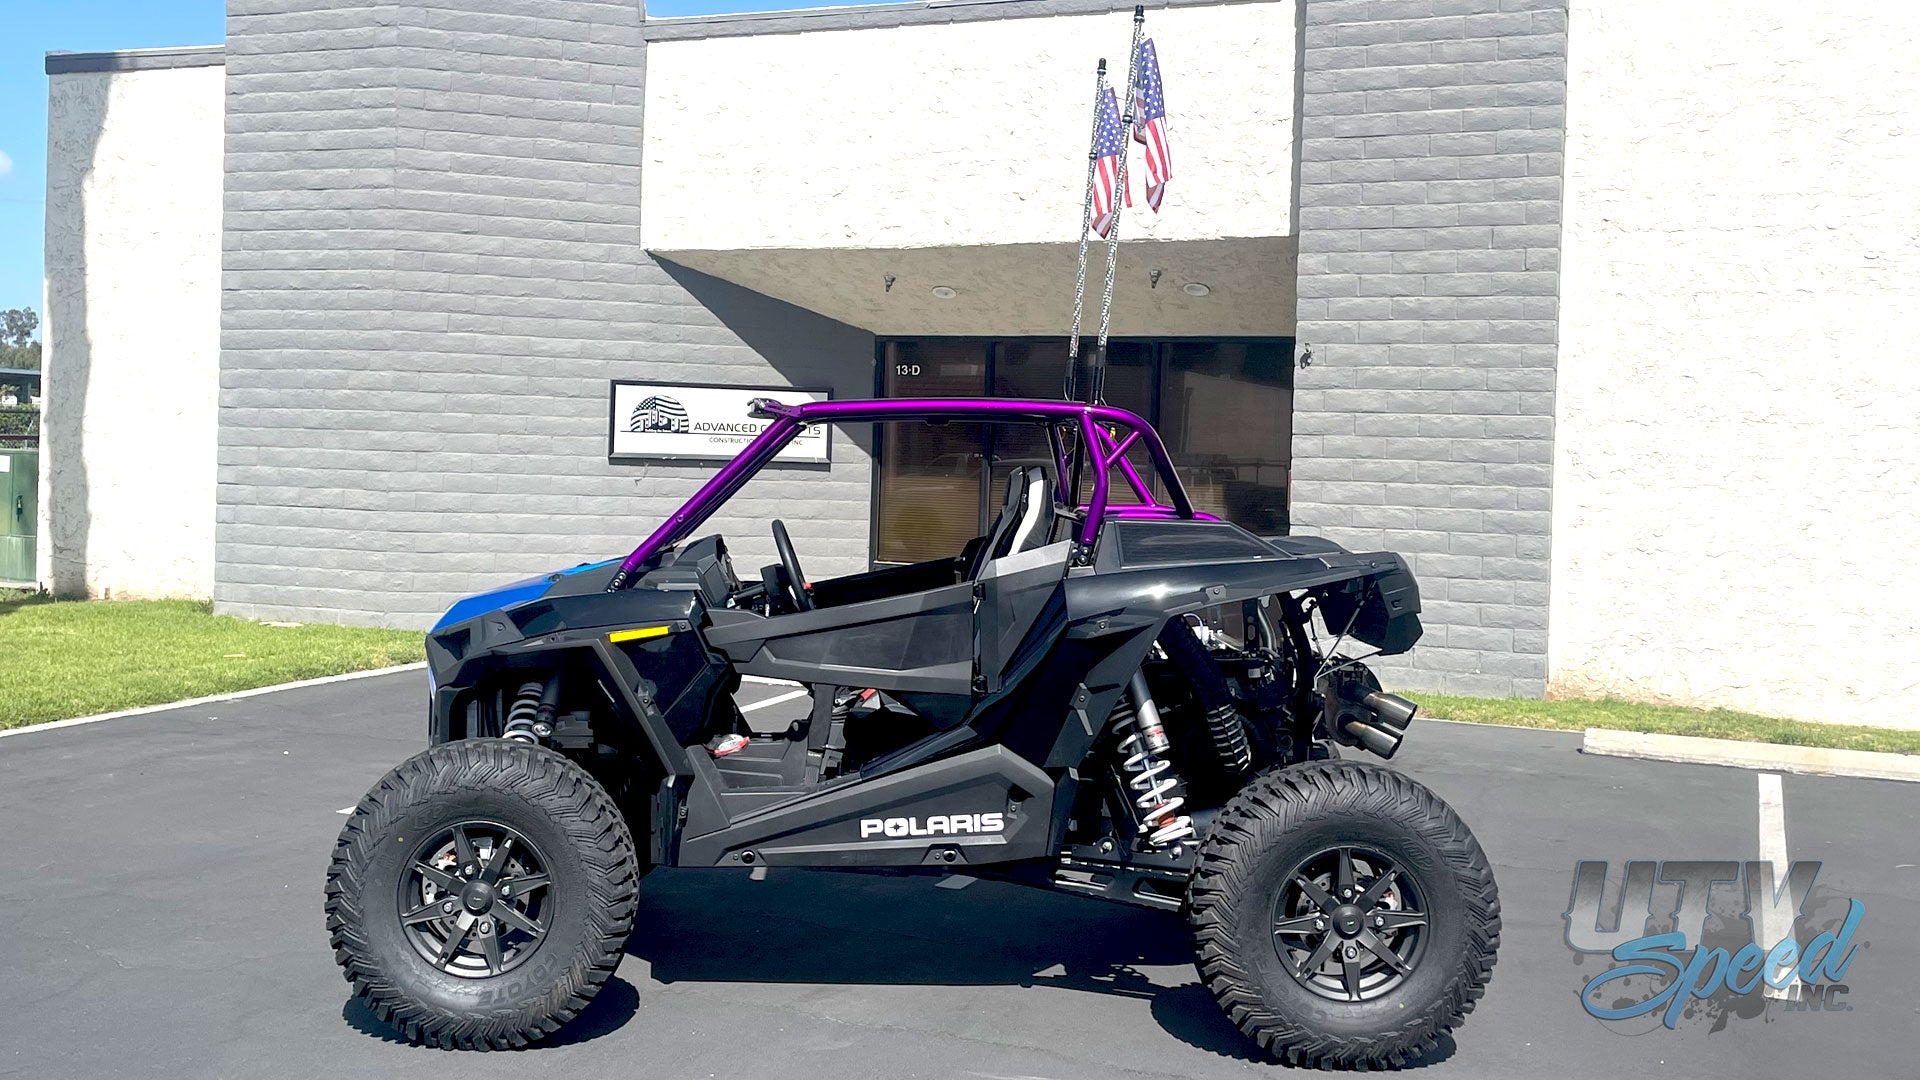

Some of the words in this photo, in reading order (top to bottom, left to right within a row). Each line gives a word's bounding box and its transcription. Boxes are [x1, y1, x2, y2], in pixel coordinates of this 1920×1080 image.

[694, 422, 757, 433] ADVANCED
[709, 436, 754, 445] CONSTRUCTIO
[860, 812, 1005, 838] POLARIS
